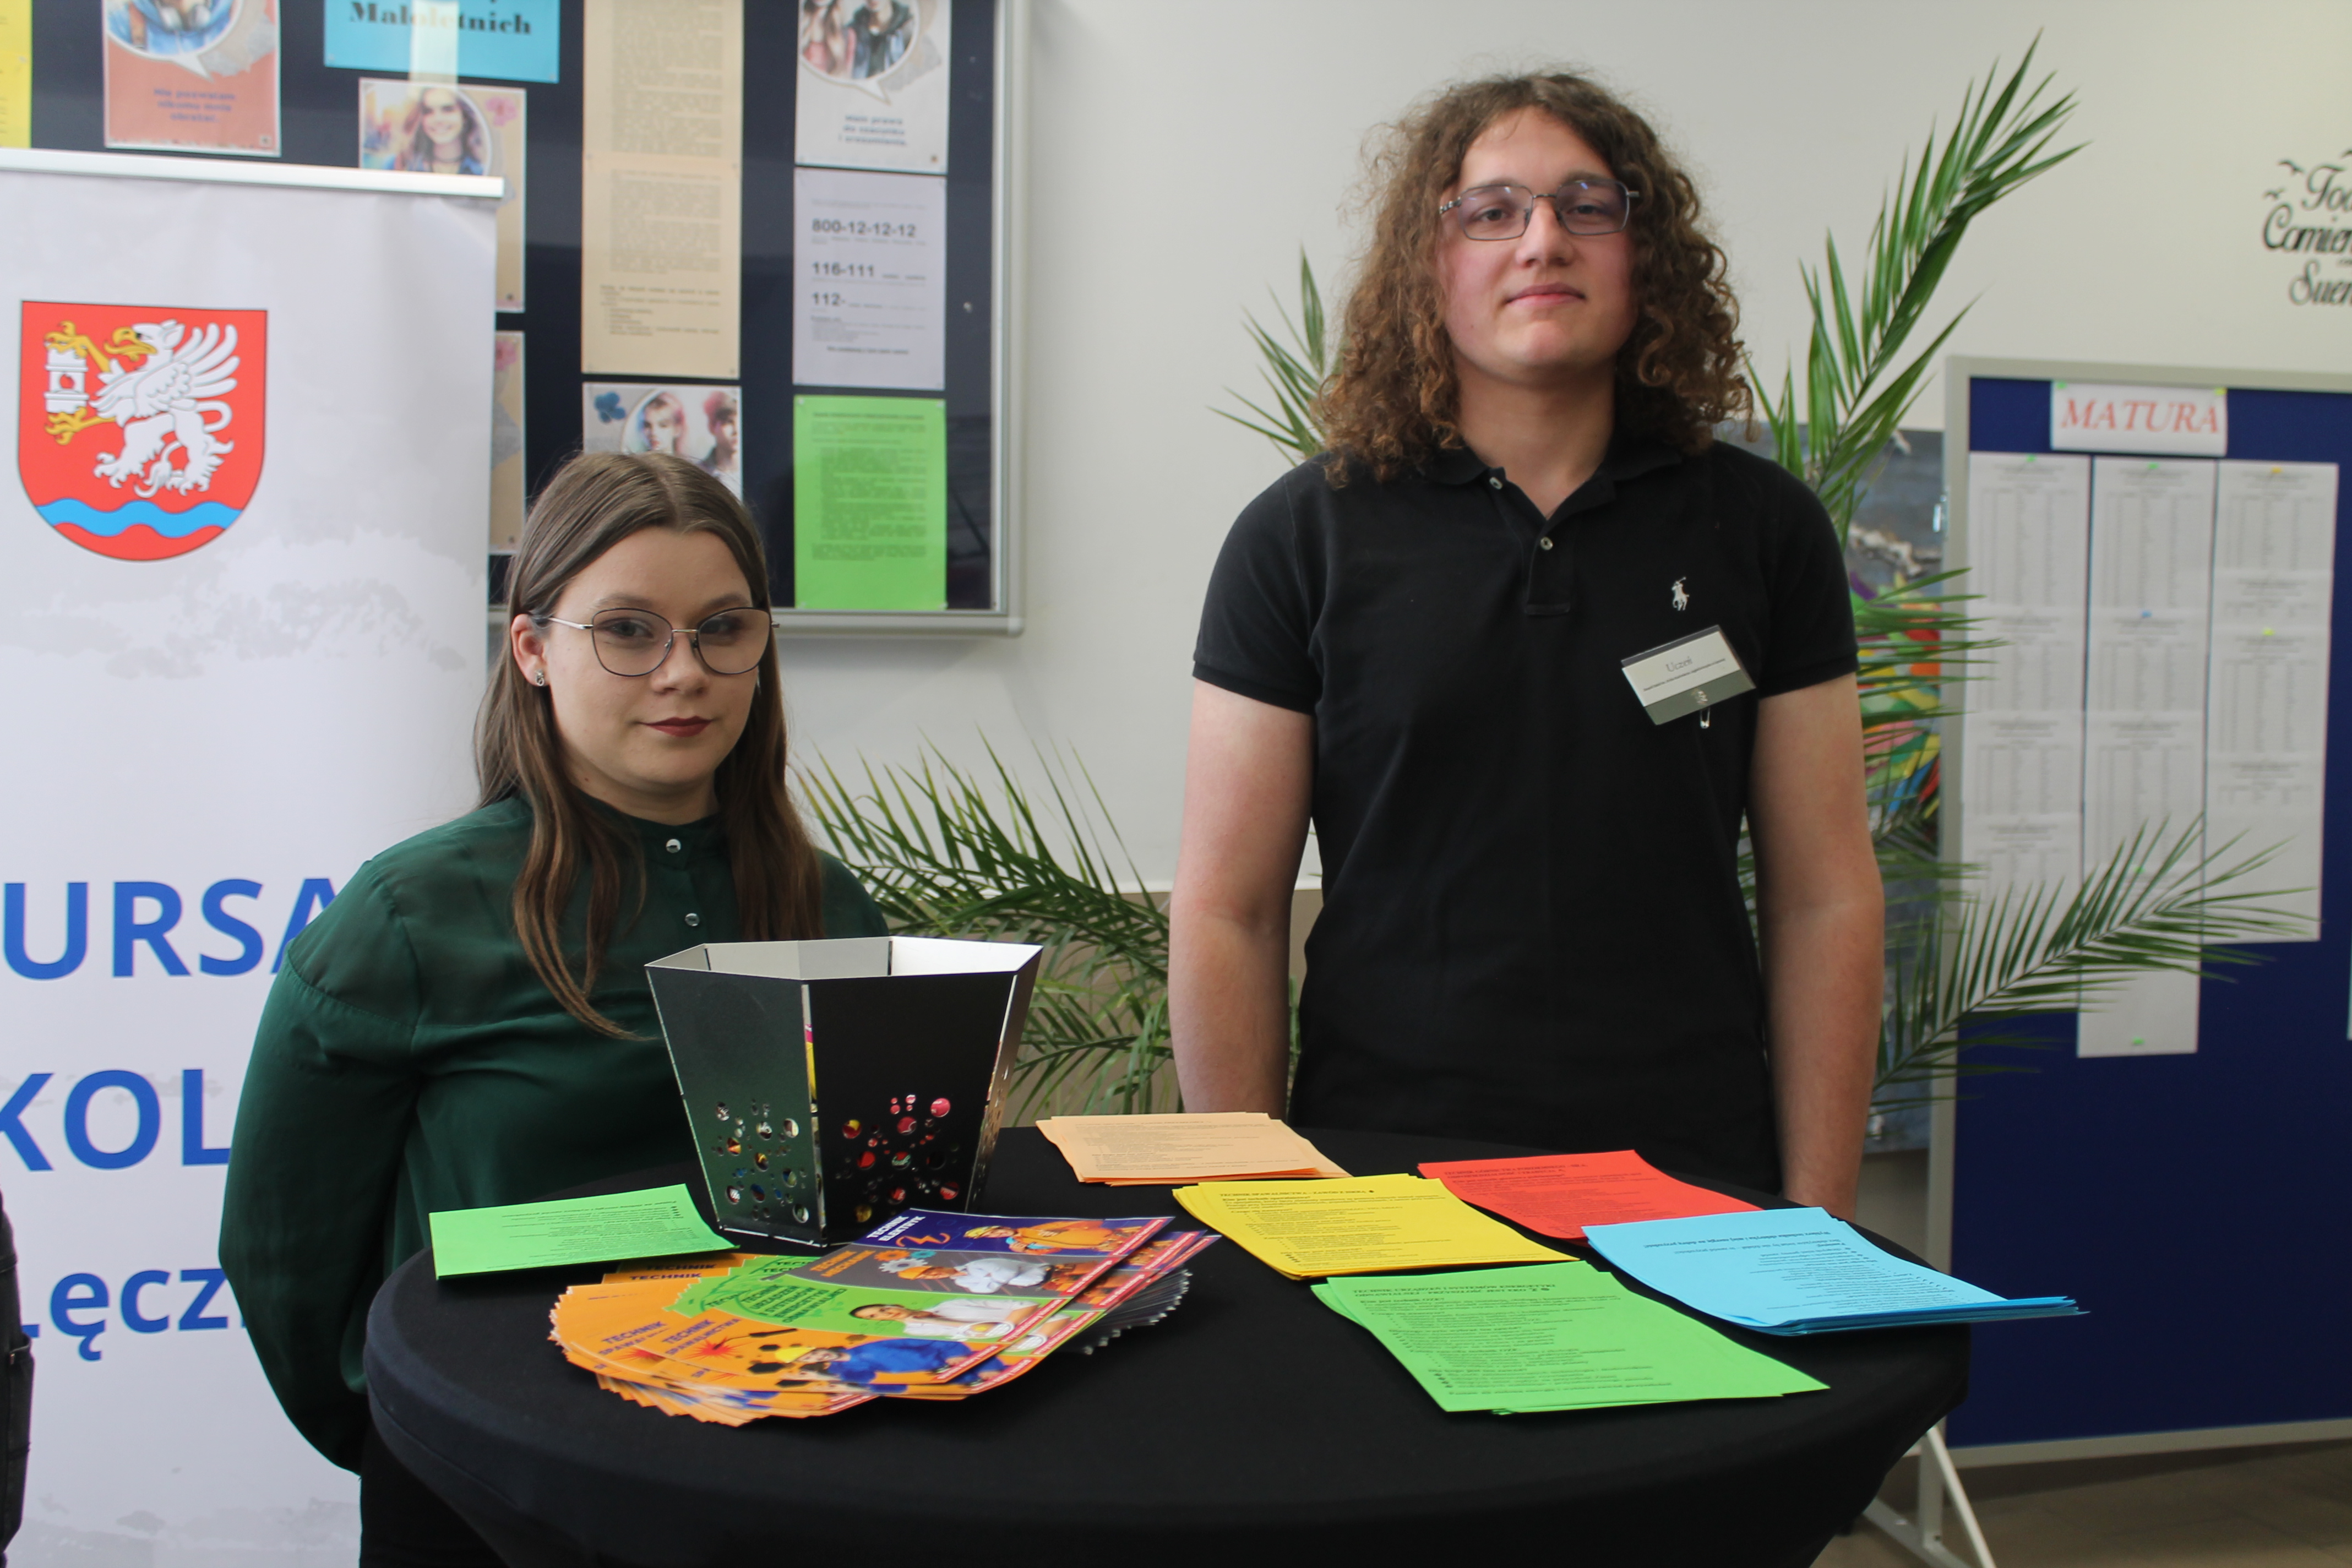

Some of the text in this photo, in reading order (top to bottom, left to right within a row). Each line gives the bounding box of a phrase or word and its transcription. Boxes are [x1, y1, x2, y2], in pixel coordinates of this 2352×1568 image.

[812, 218, 916, 237] 800-12-12-12
[812, 262, 874, 277] 116-111
[2061, 399, 2220, 434] MATURA
[866, 1216, 909, 1238] TECHNIK
[878, 1216, 926, 1242] ELEKTRYK
[601, 1321, 667, 1344] TECHNIK
[662, 1319, 716, 1344] TECHNIK
